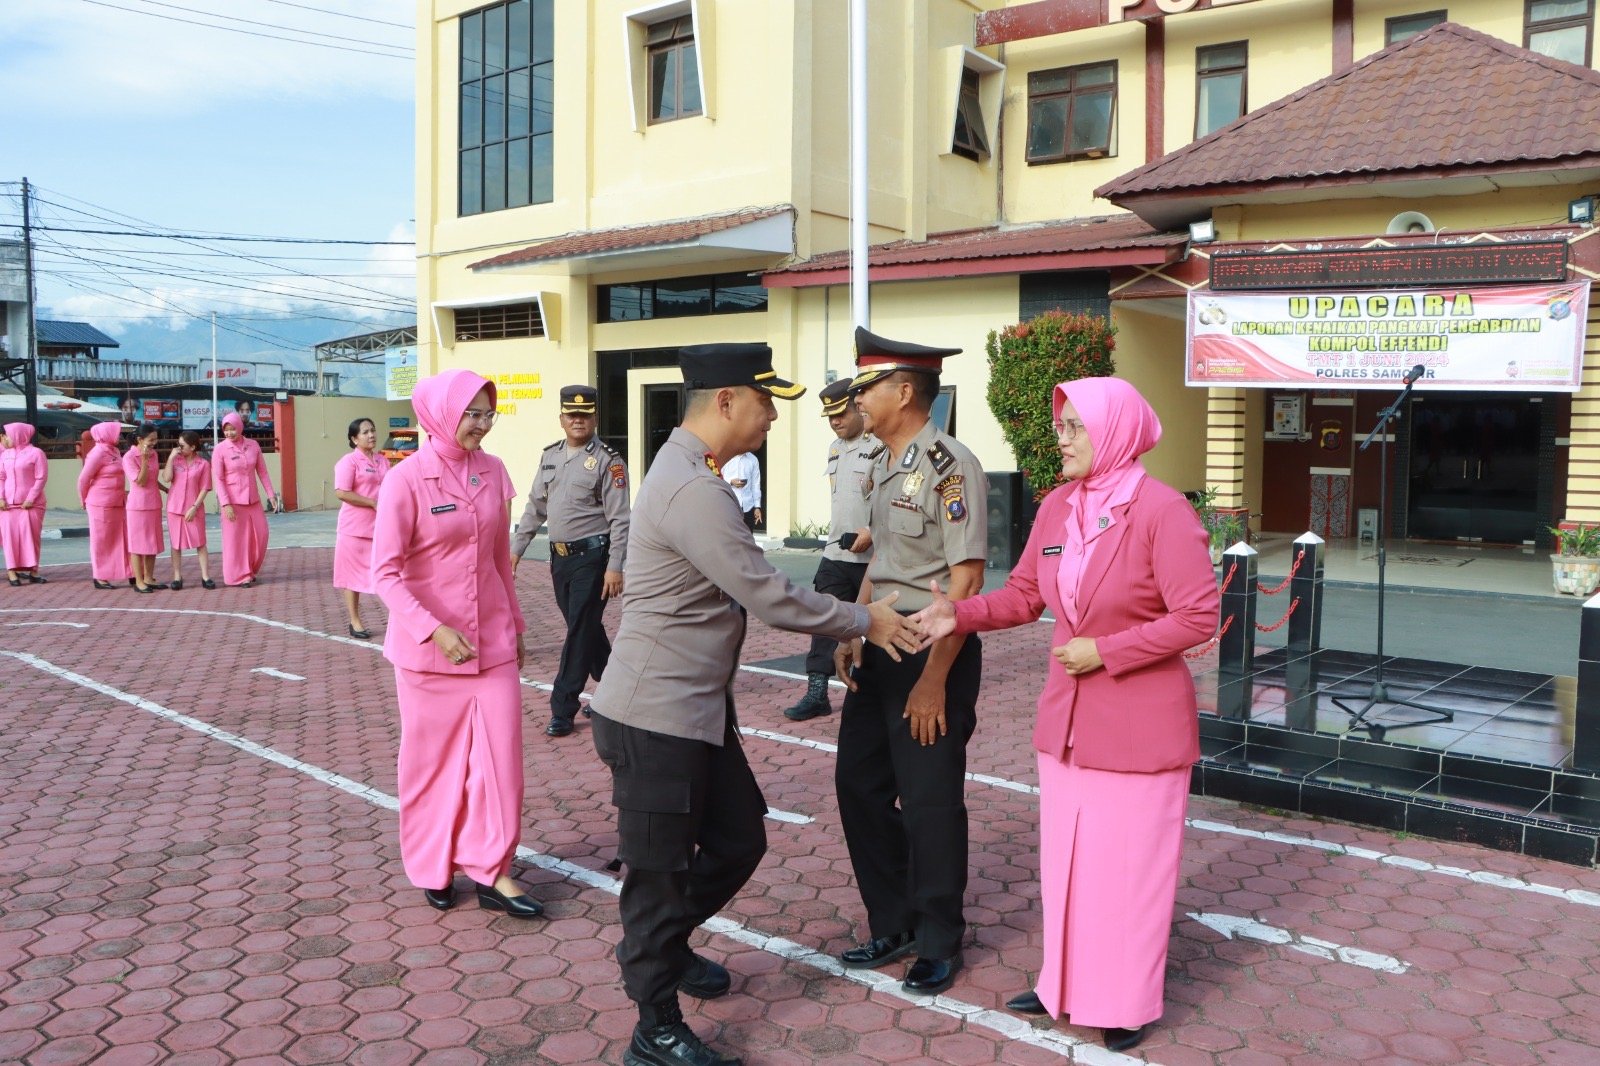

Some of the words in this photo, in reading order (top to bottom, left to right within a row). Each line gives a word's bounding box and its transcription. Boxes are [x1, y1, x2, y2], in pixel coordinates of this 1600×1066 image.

[1288, 294, 1473, 318] UPACARA
[1232, 321, 1293, 335] LAPORAN
[1295, 320, 1367, 335] KENAIKAN
[1369, 320, 1437, 334] PANGKAT
[1439, 318, 1541, 333] PENGABDIAN
[1308, 336, 1377, 352] KOMPOL
[1379, 335, 1448, 351] EFFENDI
[1306, 353, 1343, 367] TMT
[1347, 353, 1356, 367] 1
[1360, 353, 1401, 367] JUNI
[1405, 353, 1449, 367] 2024
[1316, 369, 1368, 378] POLRES
[1372, 368, 1435, 378] SAMOR
